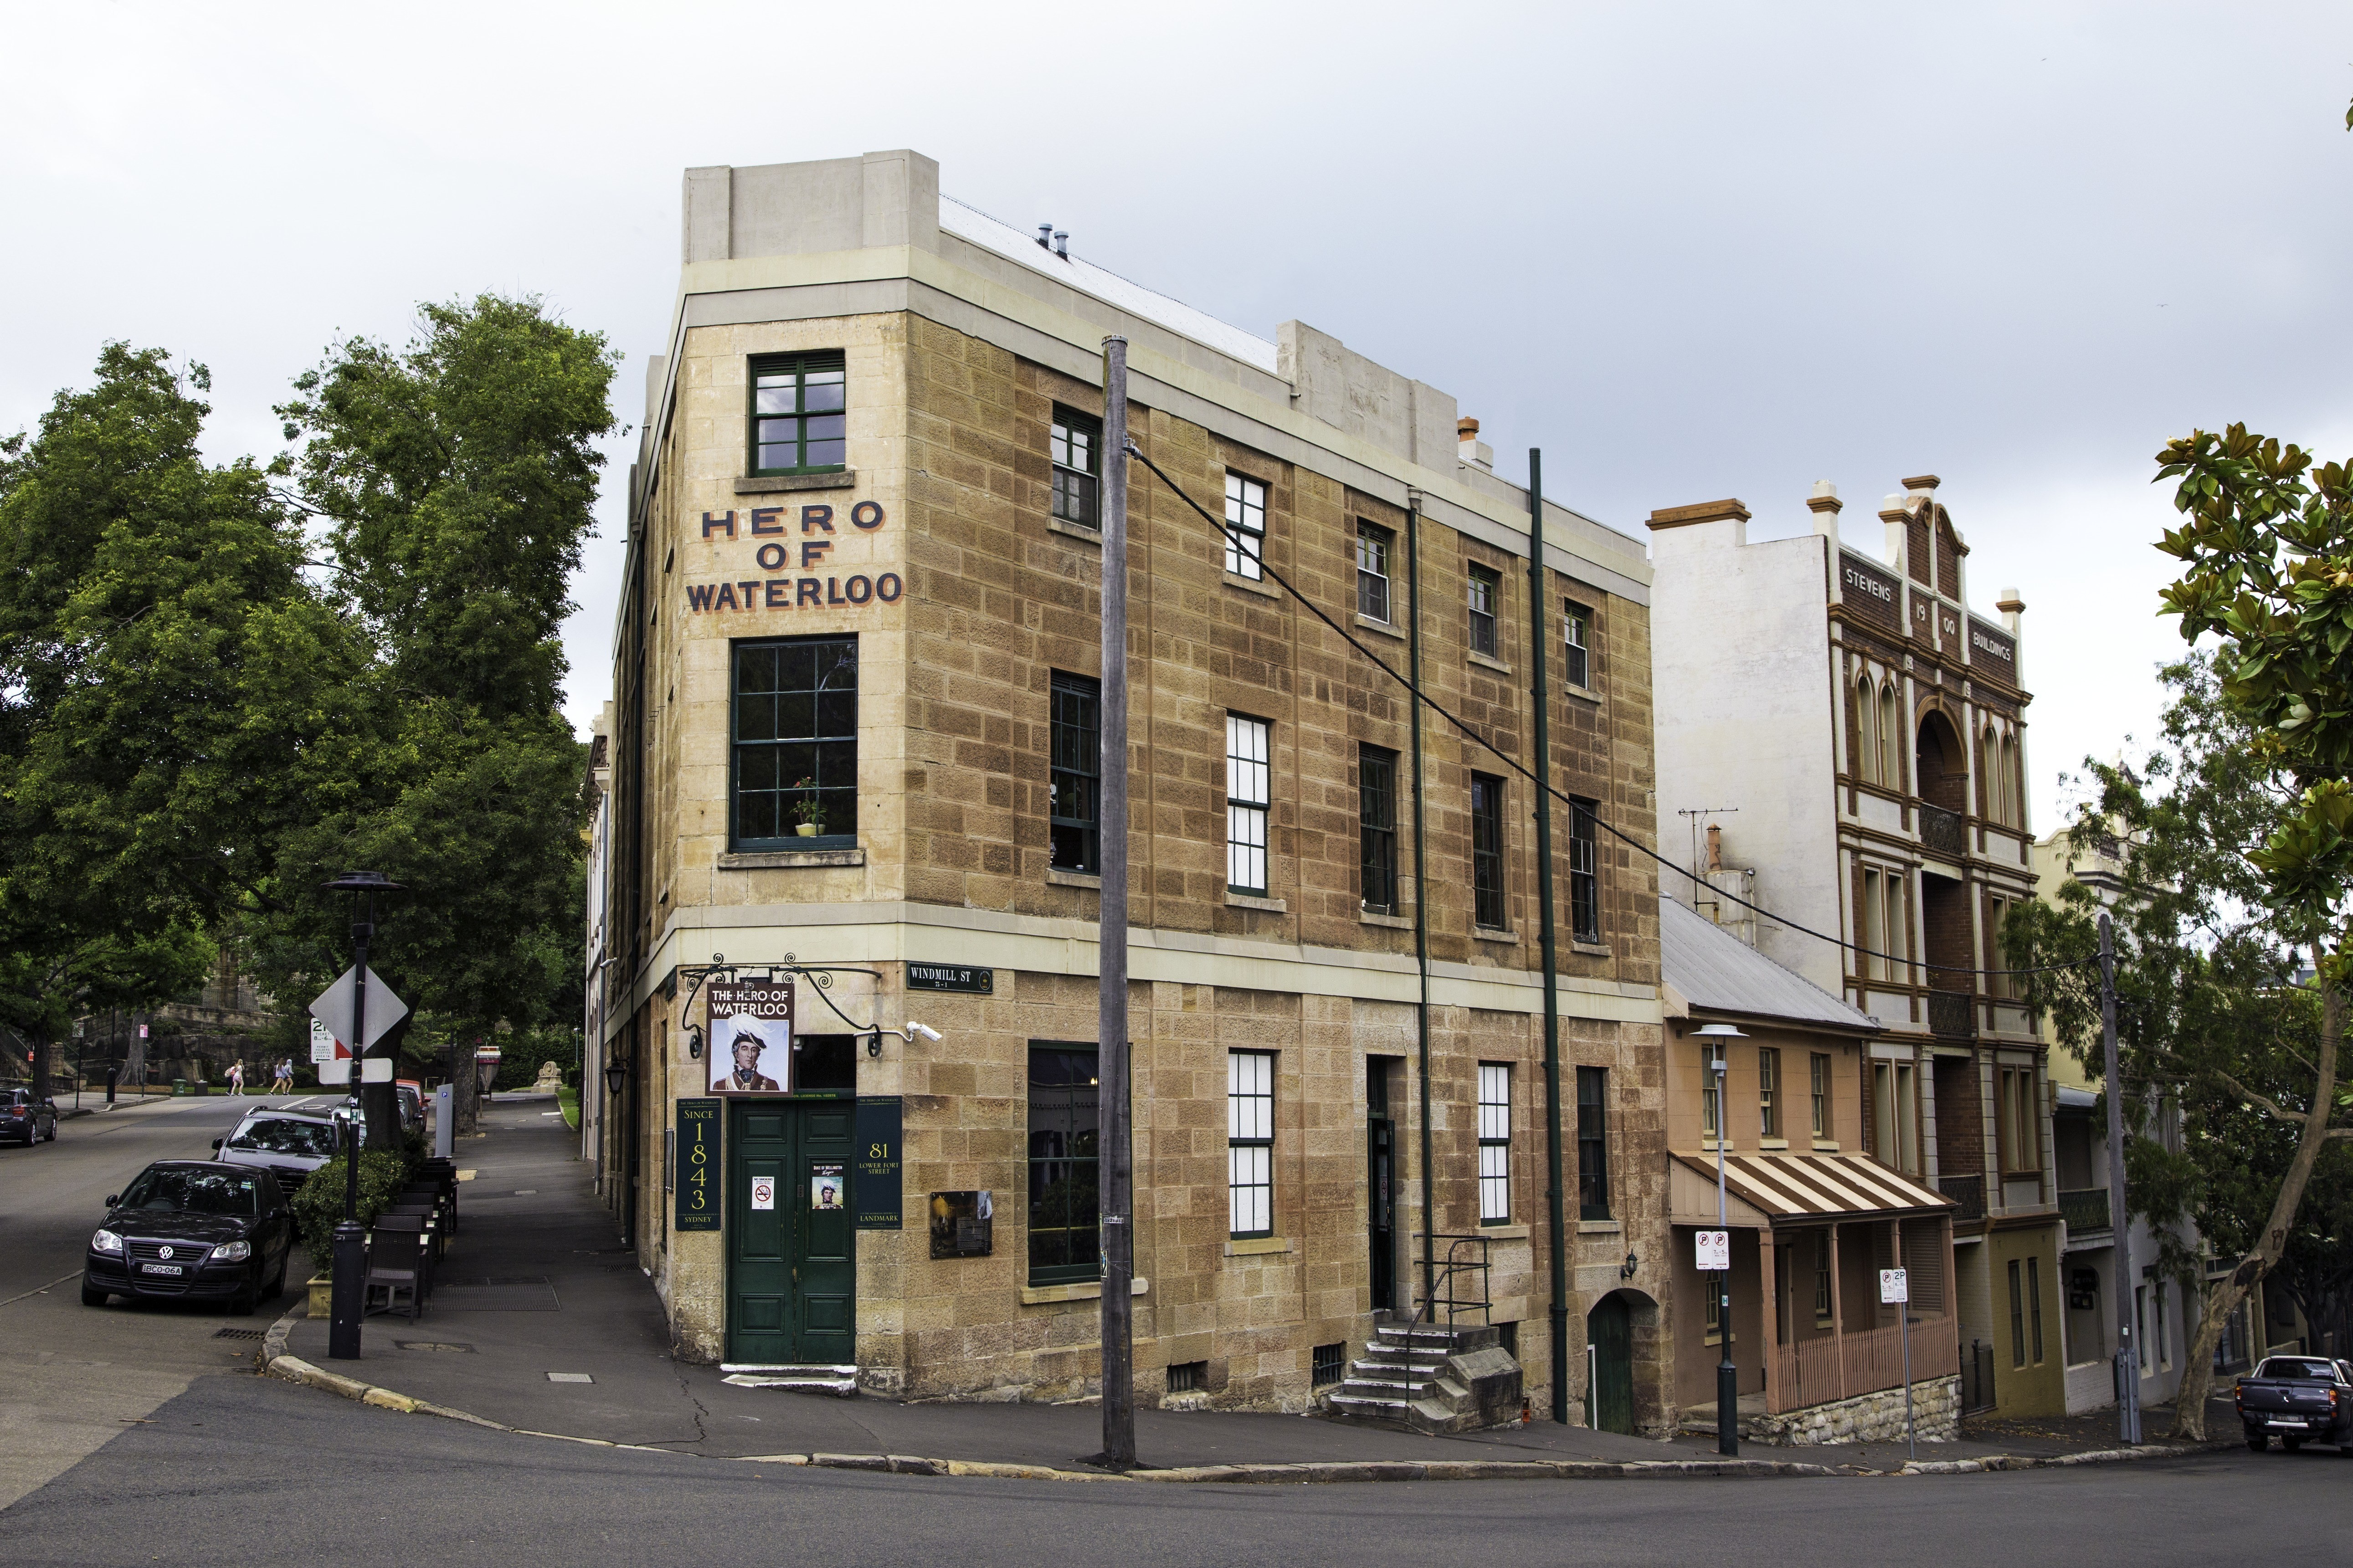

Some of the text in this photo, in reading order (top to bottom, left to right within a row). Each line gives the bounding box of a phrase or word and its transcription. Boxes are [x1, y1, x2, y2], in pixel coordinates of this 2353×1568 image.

[702, 501, 885, 541] HERO
[756, 541, 833, 571] OF
[686, 573, 903, 615] WATERLOO
[1846, 569, 1891, 602] STEVENS
[1916, 602, 1926, 621] 19
[1973, 632, 2010, 661] BUILDINGS
[911, 967, 956, 981] WINDMILL
[961, 971, 971, 982] ST
[712, 990, 732, 1001] THE
[771, 990, 788, 1001] OF
[712, 1003, 787, 1015] WATERLOO
[351, 1112, 358, 1121] H
[684, 1110, 714, 1119] SINCE
[870, 1143, 889, 1158] 81
